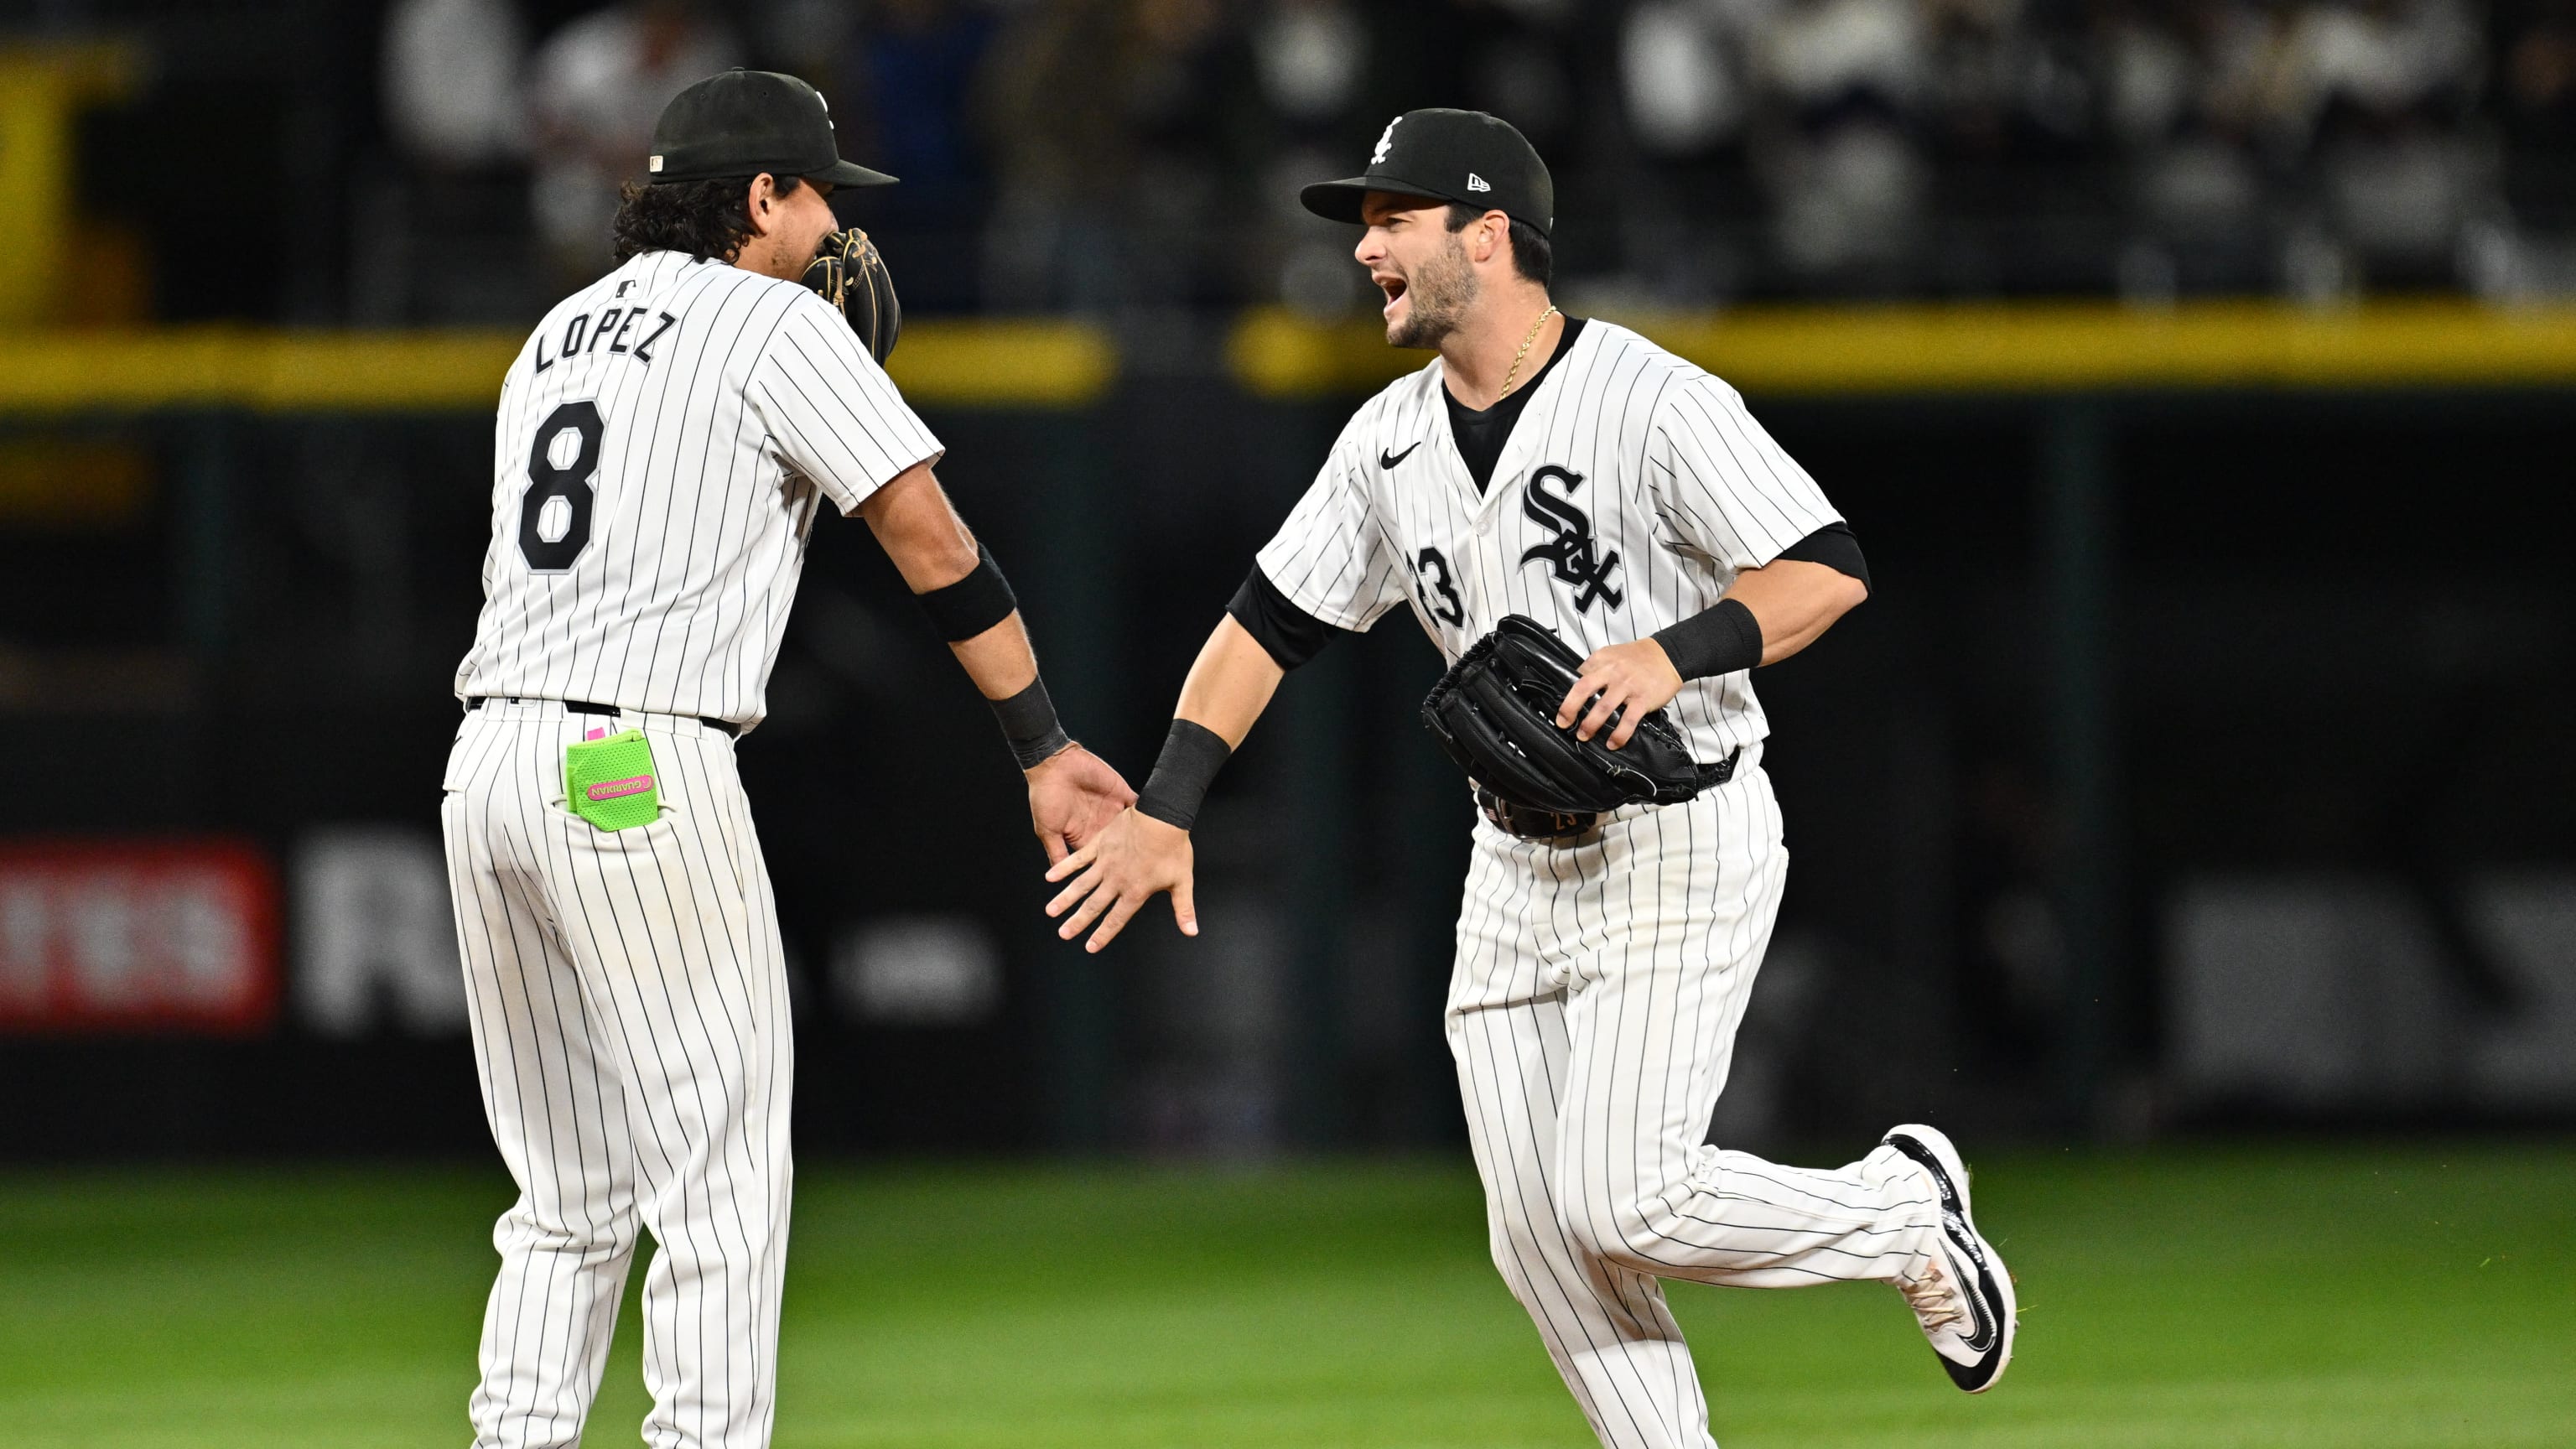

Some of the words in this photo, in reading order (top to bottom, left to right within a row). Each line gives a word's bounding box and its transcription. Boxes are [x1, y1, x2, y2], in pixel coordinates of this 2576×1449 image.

[534, 306, 678, 377] LOPEZ
[515, 397, 609, 575] 8
[591, 780, 642, 797] GUARDIAN
